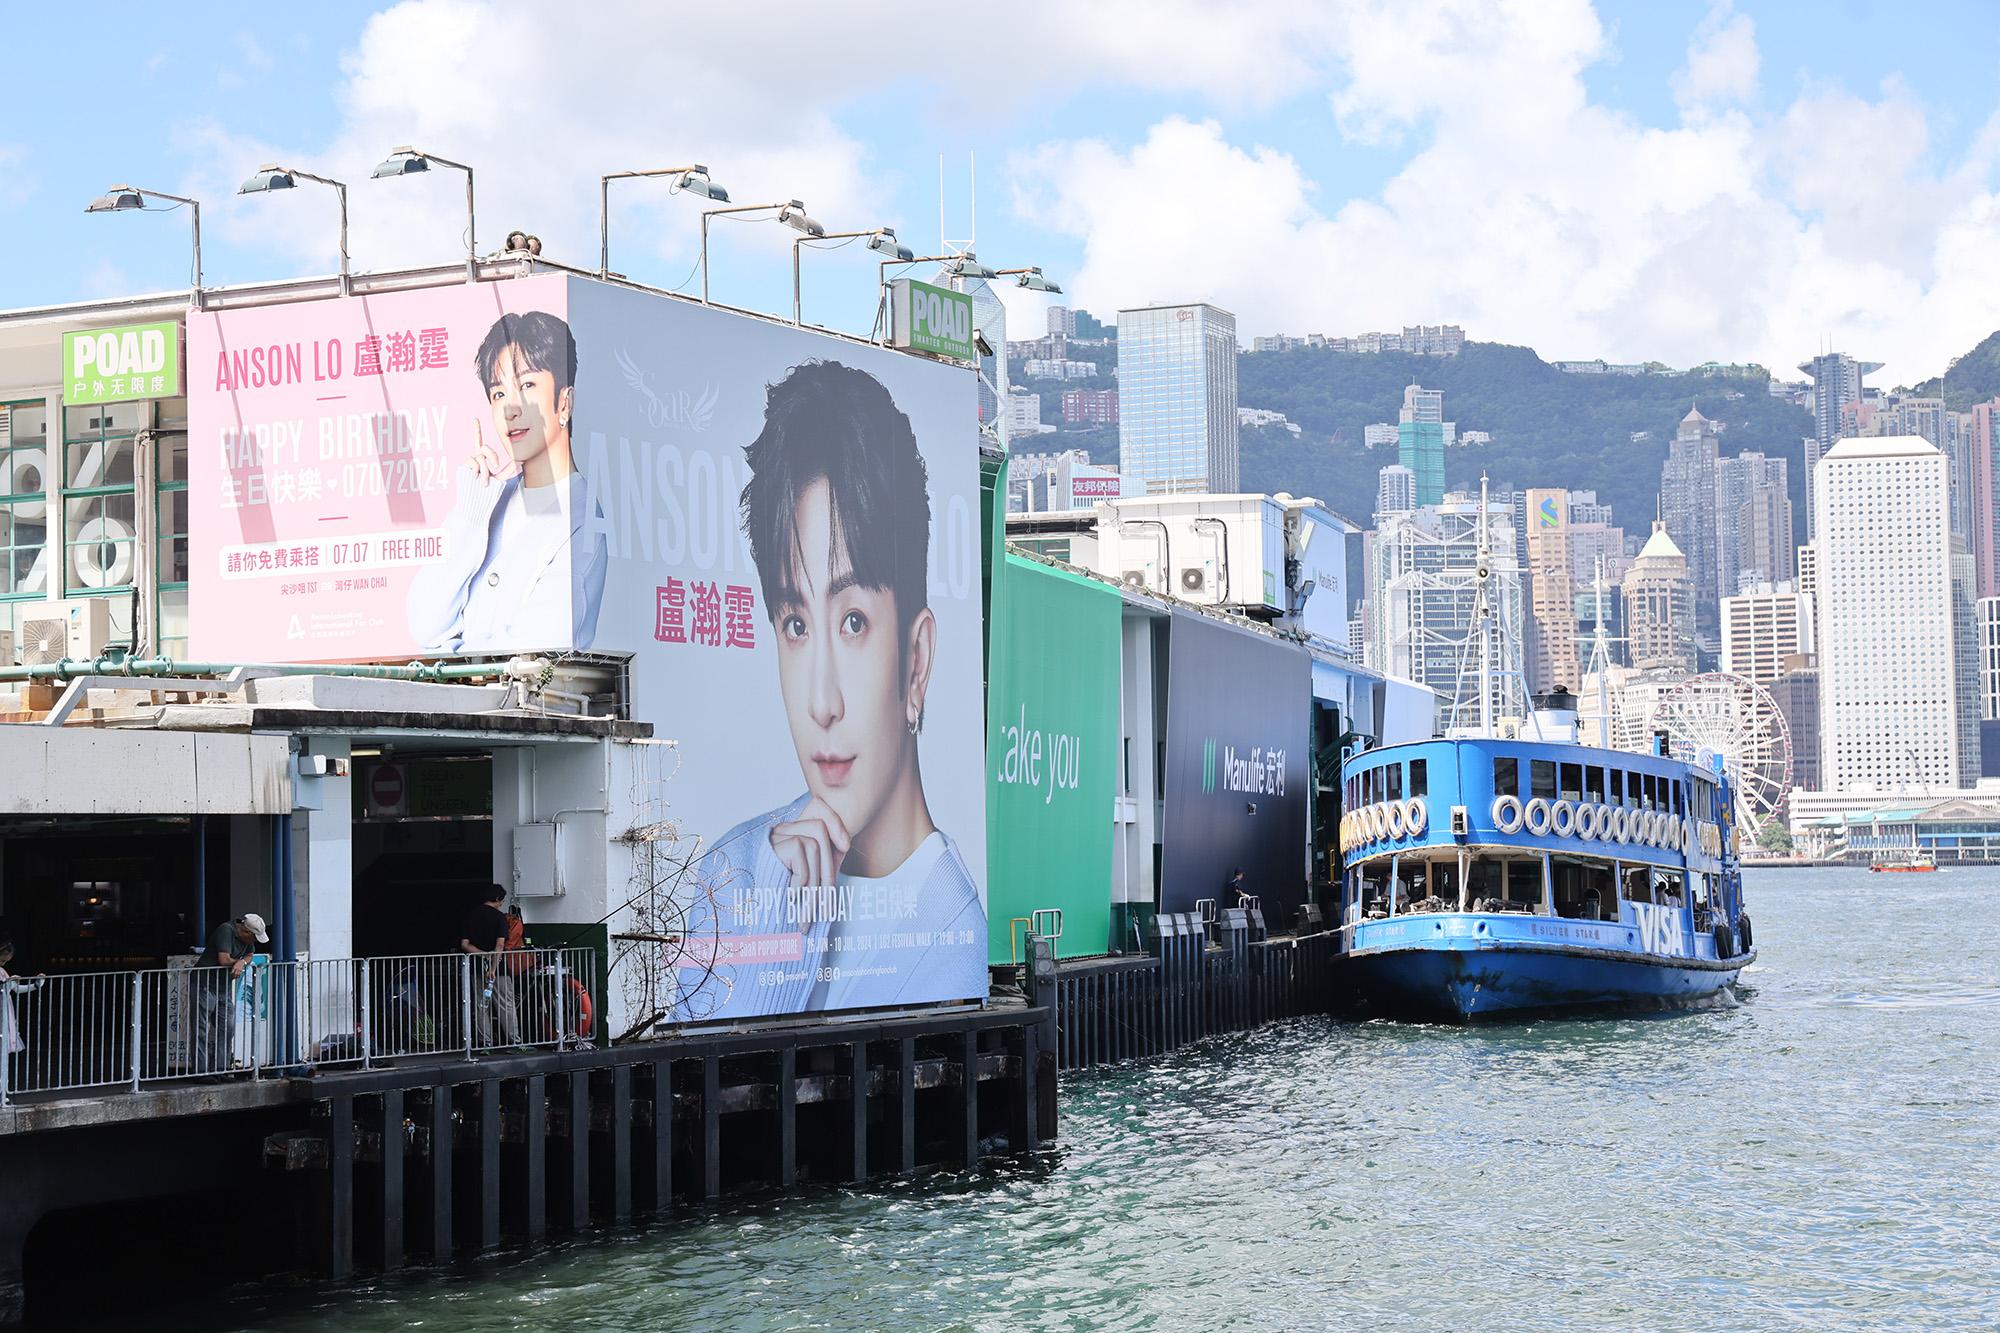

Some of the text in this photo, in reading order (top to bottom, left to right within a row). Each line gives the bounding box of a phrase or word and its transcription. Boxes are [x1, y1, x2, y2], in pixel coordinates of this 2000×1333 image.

[913, 288, 969, 343] POAD
[73, 330, 165, 378] POAD
[215, 327, 449, 392] ANSON LO 盧瀚霆
[73, 376, 165, 399] 户外无限度
[219, 405, 448, 470] HAPPY BIRTHDAY
[219, 456, 449, 508] 生日快樂 07072024
[583, 432, 971, 600] ANSON LO
[227, 536, 443, 573] 請你免費乘搭 07.07 FREE RIDE
[353, 577, 370, 590] WAN
[371, 576, 388, 588] CHAI
[654, 576, 755, 649] 盧瀚霆
[1046, 733, 1080, 804] you
[1223, 746, 1286, 797] Manulife 宏利
[733, 885, 918, 926] HAPPY BIRTHDAY 生日快樂
[1632, 901, 1684, 955] VISA
[757, 940, 779, 956] POPUP
[780, 938, 798, 955] STORE
[834, 936, 842, 952] 10
